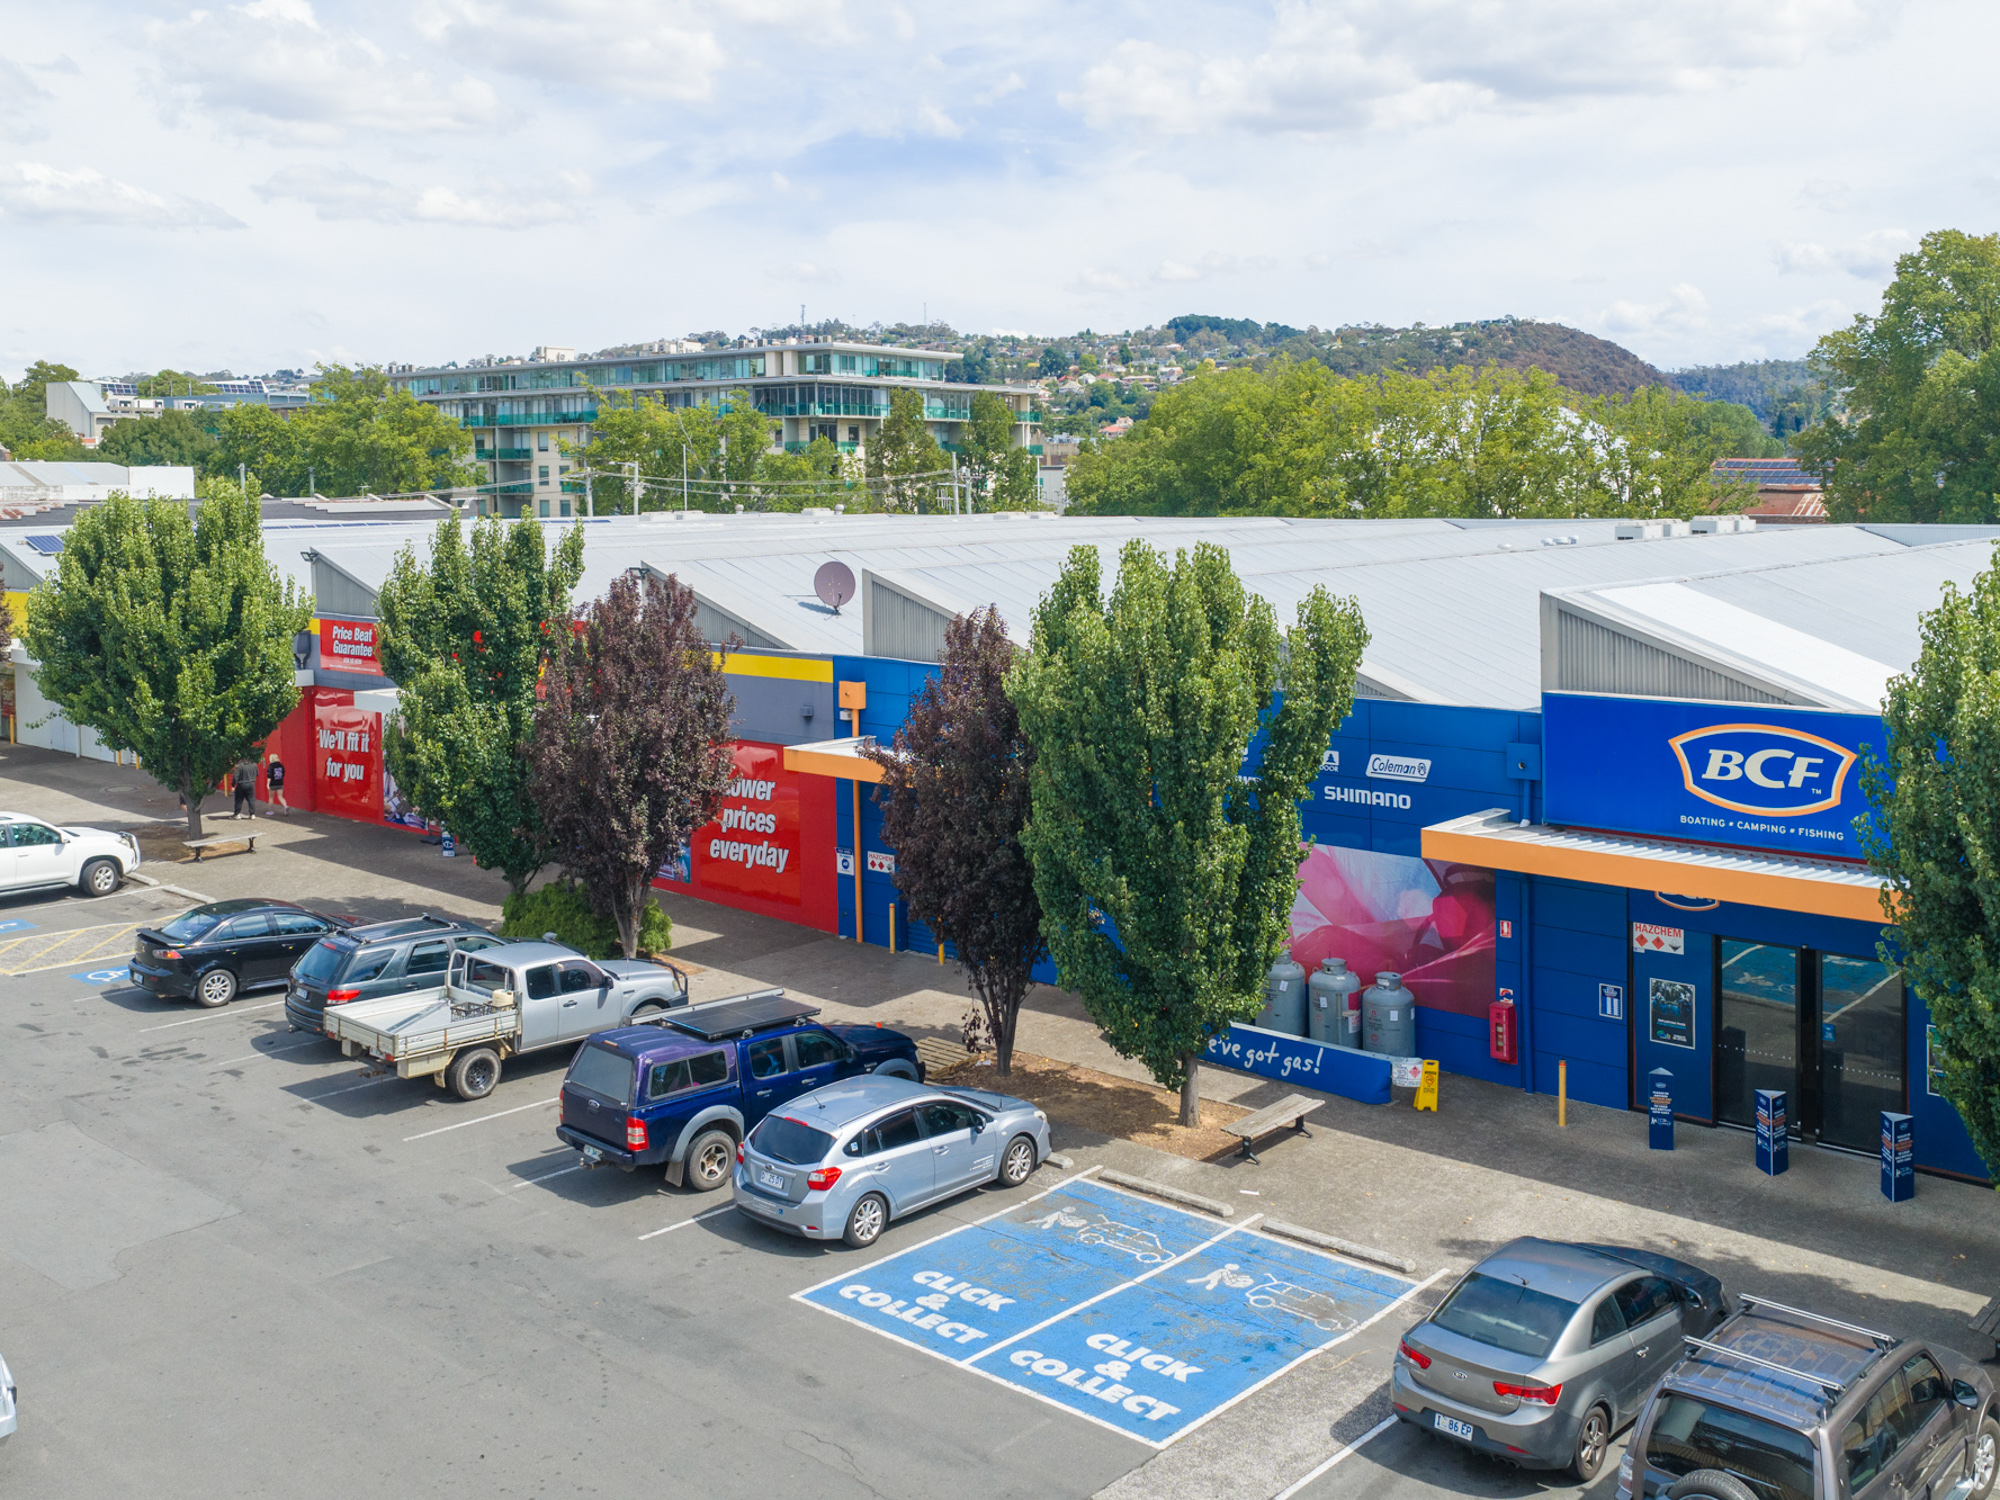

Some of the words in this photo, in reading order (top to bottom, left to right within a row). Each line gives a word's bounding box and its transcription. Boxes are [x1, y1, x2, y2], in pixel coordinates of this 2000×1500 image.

[332, 625, 353, 641] Price
[354, 627, 373, 643] Beat
[333, 640, 373, 657] Guarantee
[319, 729, 345, 750] We'll
[347, 731, 359, 753] fit
[361, 733, 370, 753] it
[326, 757, 342, 778] for
[343, 763, 365, 783] you
[1372, 756, 1416, 775] Coleman
[1701, 748, 1824, 789] BCF
[725, 778, 776, 801] ower
[1324, 785, 1411, 810] SHIMANO
[721, 805, 777, 835] prices
[1680, 815, 1726, 828] BOATING
[1737, 820, 1786, 834] CAMPING
[1798, 827, 1845, 841] FISHING
[709, 838, 790, 874] everyday
[868, 853, 894, 862] HAZCHEM
[1634, 922, 1682, 938] HAZCHEM
[1208, 1036, 1241, 1059] e've
[1244, 1041, 1280, 1069] got
[1280, 1047, 1324, 1077] gas!
[912, 1270, 1017, 1312] CLICK
[915, 1293, 950, 1311] &
[838, 1284, 989, 1344] COLLECT
[1085, 1333, 1205, 1383] CLICK
[1093, 1360, 1131, 1382] &
[1009, 1350, 1181, 1421] COLLECT
[1448, 1419, 1459, 1432] 86
[1461, 1422, 1472, 1436] EP
